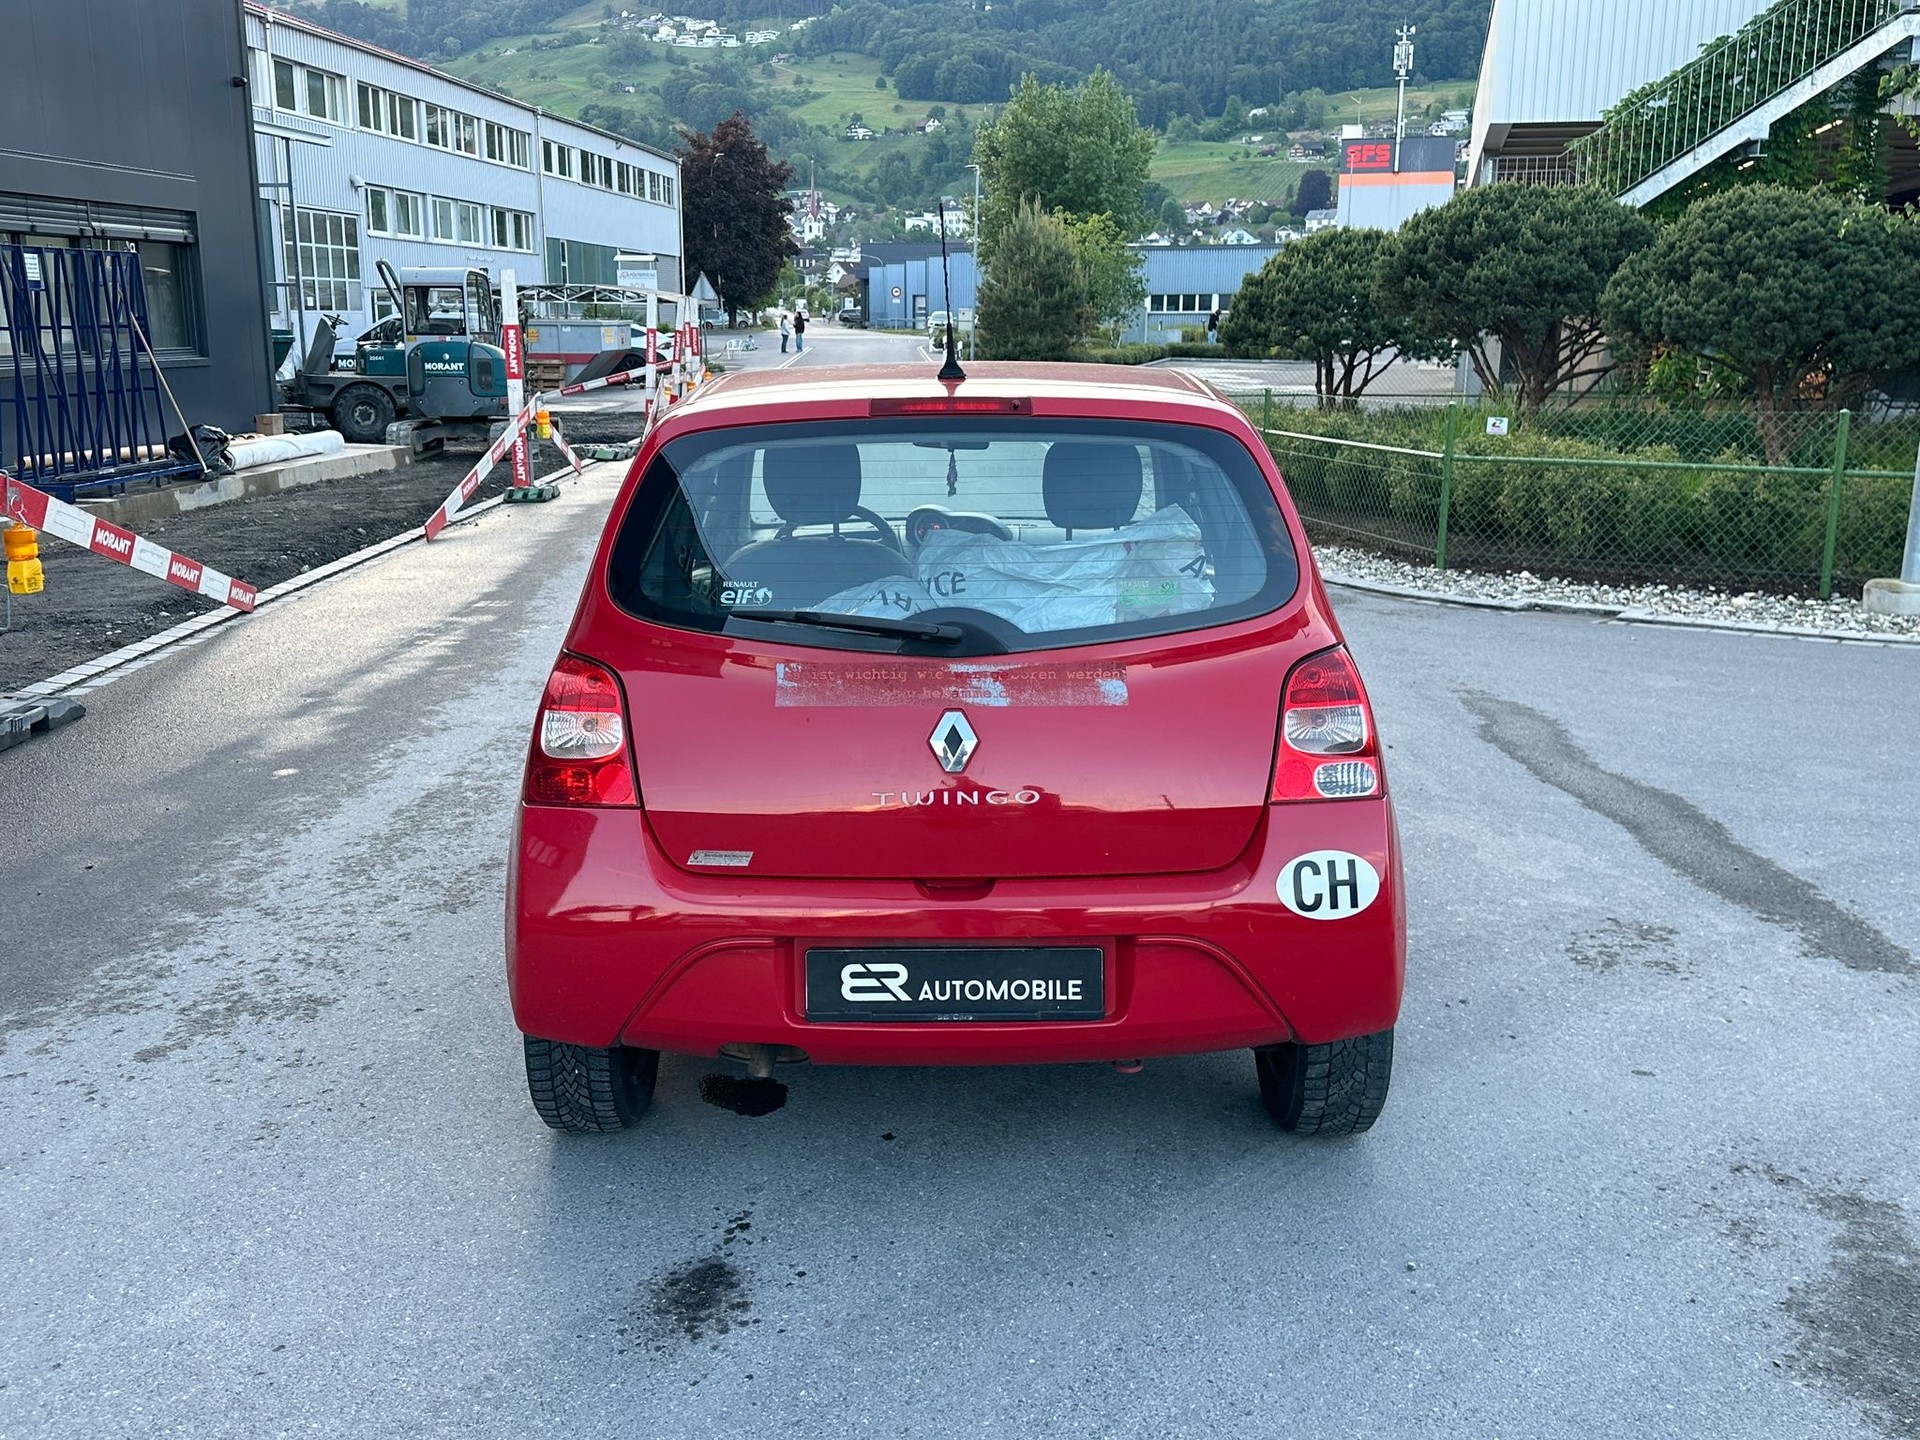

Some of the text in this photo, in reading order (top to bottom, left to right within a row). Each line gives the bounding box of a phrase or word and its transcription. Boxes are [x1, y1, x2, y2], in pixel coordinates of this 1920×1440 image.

[1347, 144, 1391, 162] SFS
[507, 329, 518, 375] MORANT
[647, 332, 656, 363] MORANT
[338, 359, 357, 368] MO
[424, 362, 465, 371] MORANT
[515, 437, 526, 481] MORANT
[95, 528, 131, 555] MORANT
[171, 561, 200, 584] MORANT
[231, 586, 254, 605] MORANT
[720, 589, 754, 604] elf
[812, 669, 835, 680] ist
[845, 669, 907, 682] wichtig
[917, 670, 944, 680] wie
[1066, 669, 1120, 680] werden
[872, 790, 1040, 806] TWINGO
[1293, 859, 1359, 912] CH
[918, 980, 1083, 1001] AUTOMOBILE
